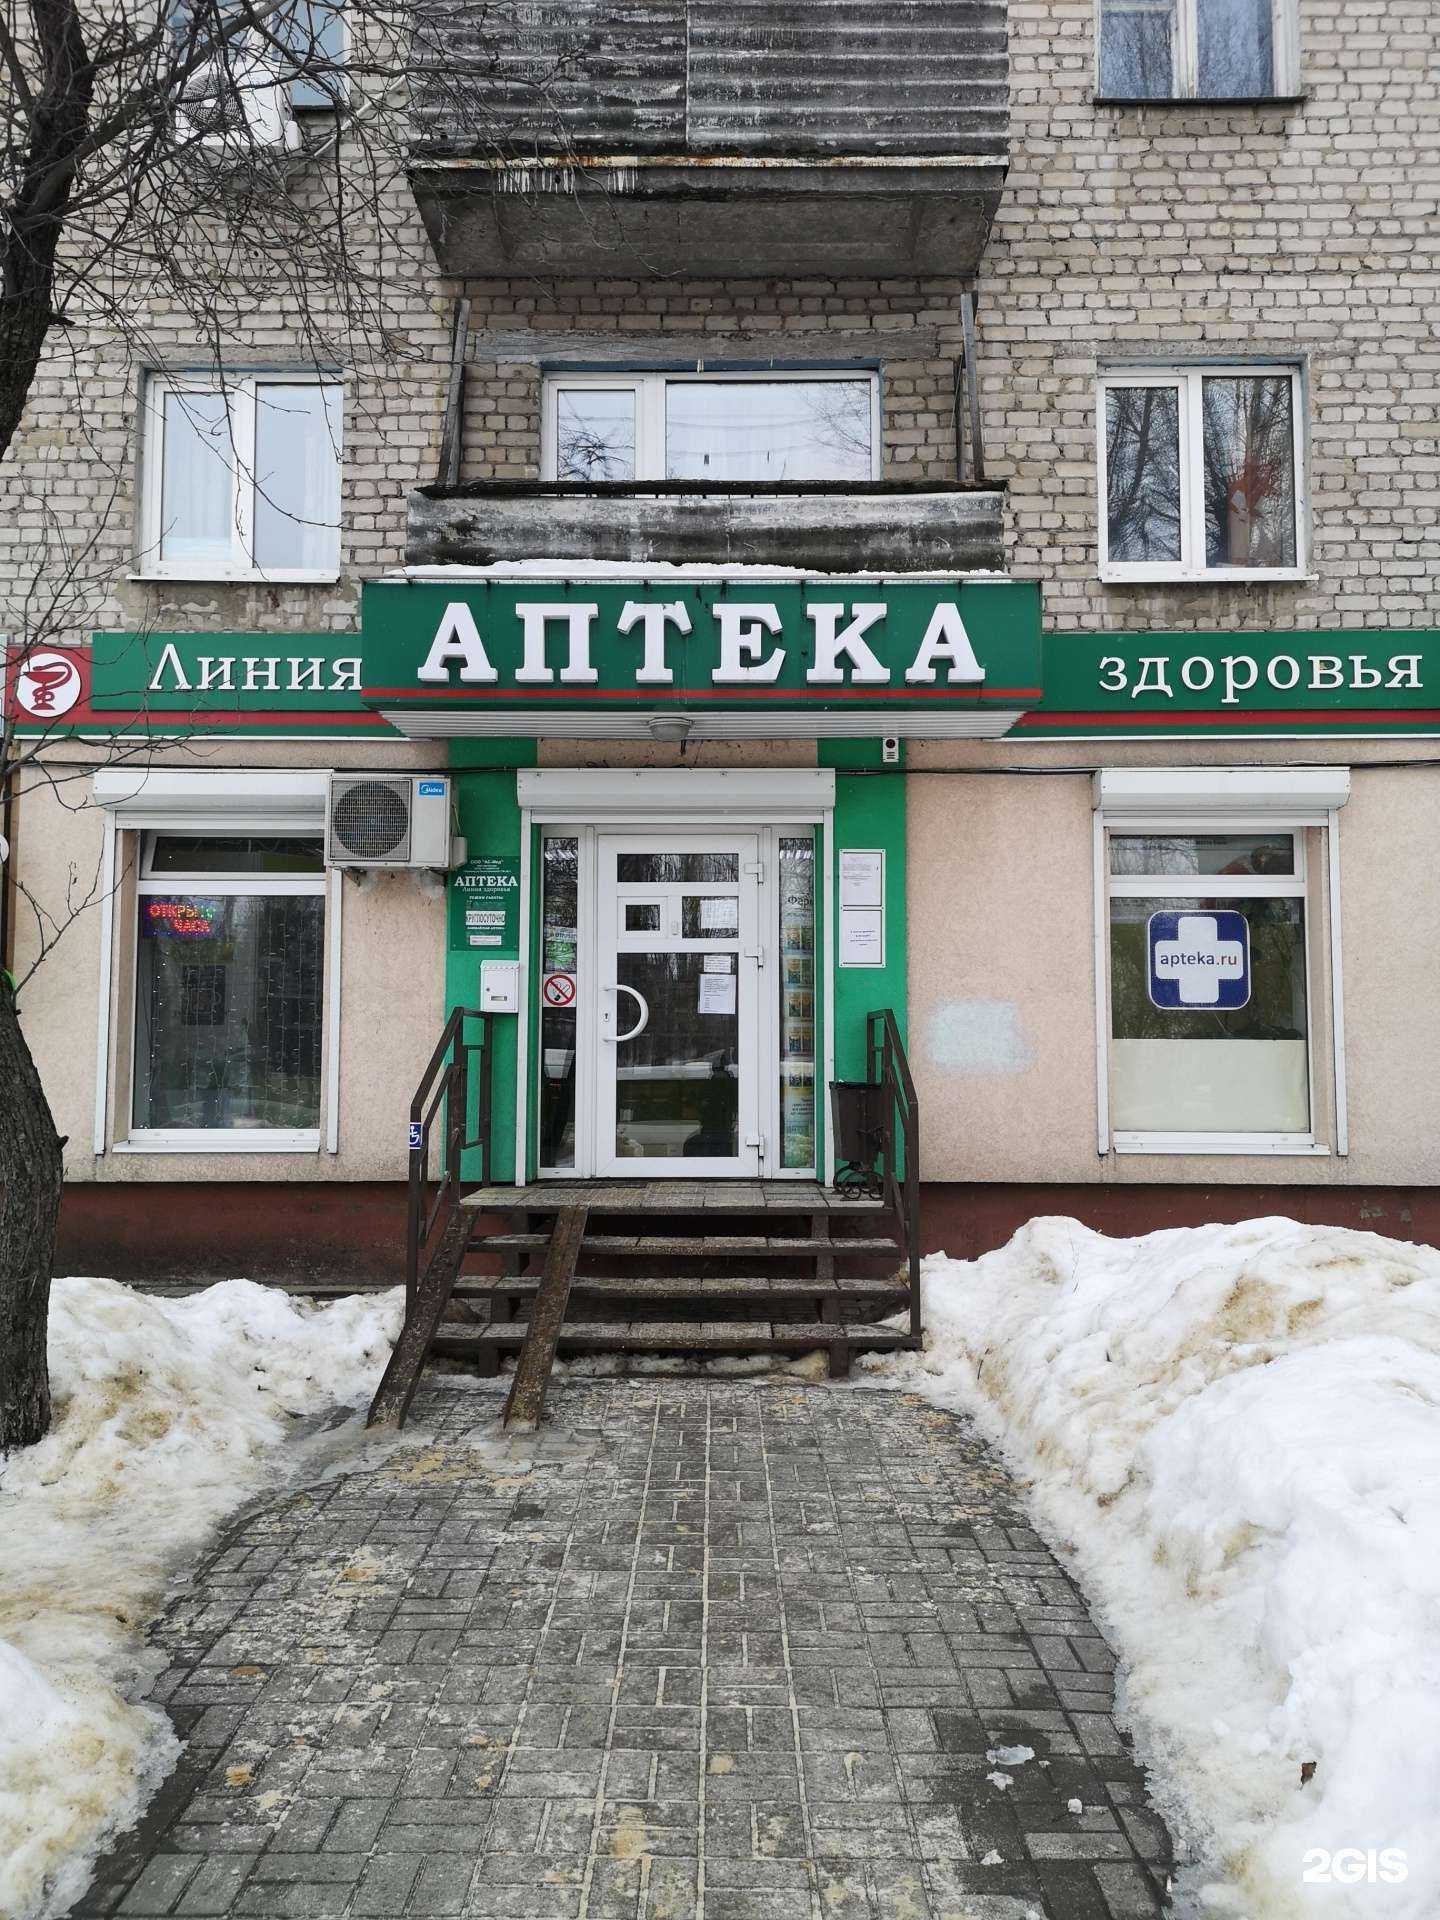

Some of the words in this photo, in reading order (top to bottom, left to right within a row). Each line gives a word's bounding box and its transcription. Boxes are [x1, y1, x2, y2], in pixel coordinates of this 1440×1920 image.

[417, 600, 986, 683] АПТЕКА
[150, 643, 363, 690] Линия
[1099, 654, 1424, 703] здоровья
[454, 875, 518, 887] АПТЕКА
[1160, 952, 1237, 967] apteka.ru
